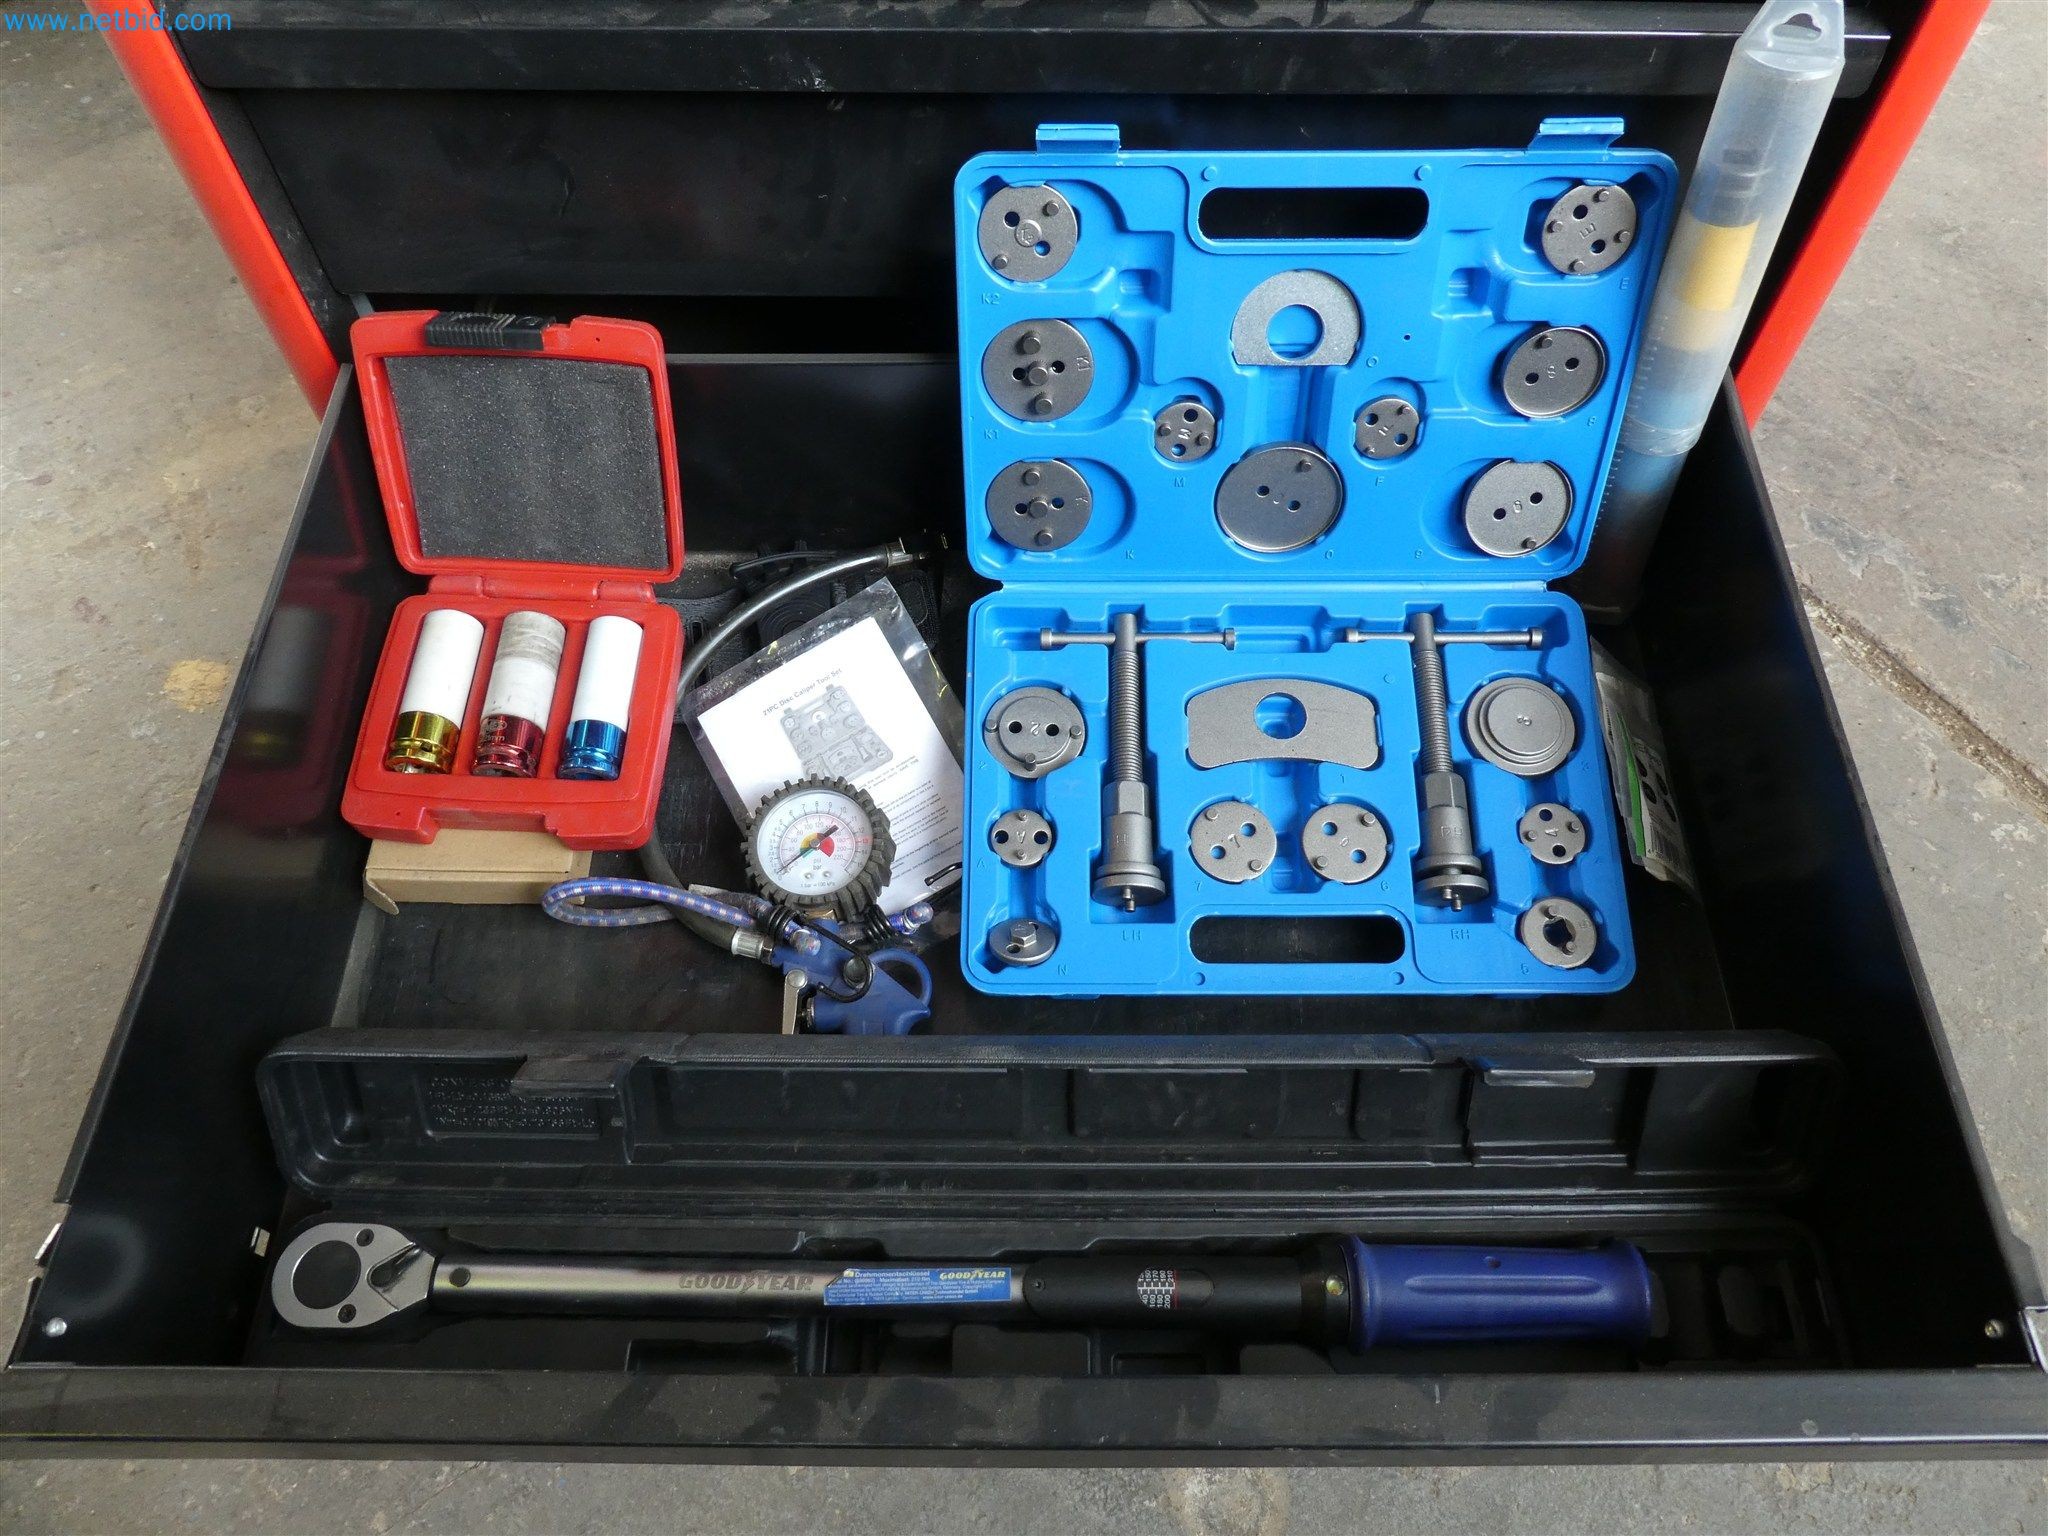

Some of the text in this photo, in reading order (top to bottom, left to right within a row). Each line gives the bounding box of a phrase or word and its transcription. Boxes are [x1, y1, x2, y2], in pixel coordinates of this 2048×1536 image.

[982, 292, 1000, 305] K2
[984, 429, 1000, 440] K1
[1174, 476, 1184, 488] M
[1125, 550, 1136, 560] K
